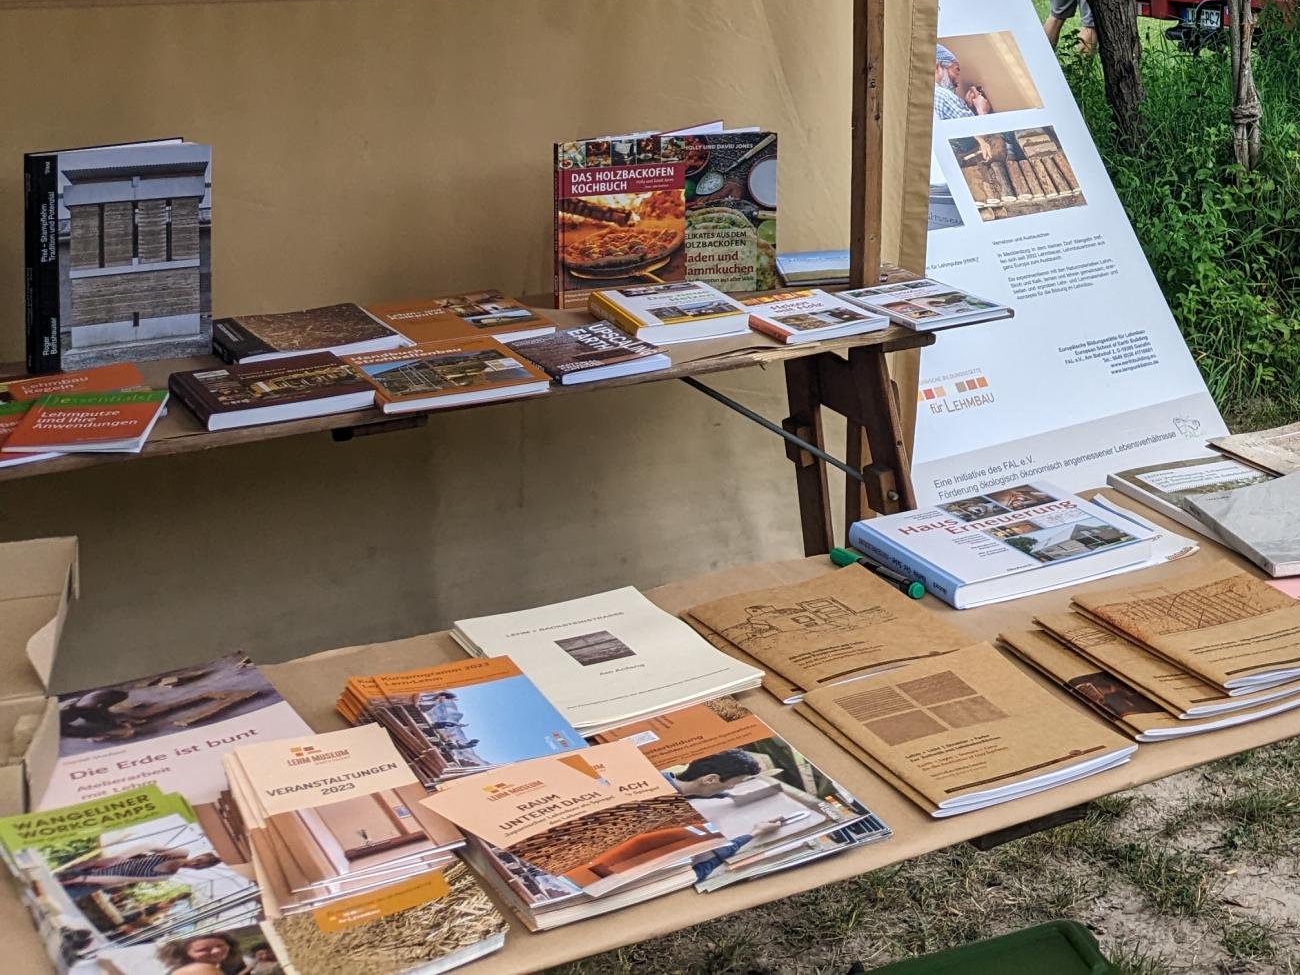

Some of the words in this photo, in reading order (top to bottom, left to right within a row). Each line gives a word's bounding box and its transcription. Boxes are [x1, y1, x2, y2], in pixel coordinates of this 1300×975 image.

[704, 143, 716, 151] UND
[716, 143, 735, 151] DAVID
[571, 171, 593, 184] DAS
[596, 167, 675, 182] HOLZBACKOFEN
[571, 181, 628, 195] KOCHBUCH
[685, 232, 715, 241] ELIKATES
[716, 231, 730, 239] AUS
[730, 231, 747, 239] DEM
[686, 240, 747, 249] OLZBACKOFEN
[685, 251, 714, 263] laden
[717, 251, 739, 261] und
[685, 264, 754, 277] lammkuchen
[42, 336, 52, 357] Roger
[568, 327, 612, 351] EARTH
[588, 323, 657, 357] UPSCALING
[351, 347, 424, 362] Handbuch
[354, 347, 463, 365] Strohballenbau
[20, 375, 88, 391] Lehmbau
[23, 383, 75, 395] Regeln
[930, 403, 943, 415] für
[943, 393, 995, 413] LEHMBAU
[41, 409, 120, 418] Lehmputze
[32, 419, 138, 430] Anwendungen
[933, 477, 952, 489] Eine
[953, 469, 987, 484] Initiative
[988, 464, 1003, 475] des
[1003, 459, 1020, 472] FAL
[1020, 455, 1036, 466] e.V.
[938, 483, 980, 501] Förderung
[980, 472, 1020, 489] ökologisch
[1020, 462, 1062, 479] ökonomisch
[1063, 447, 1114, 467] angemessener
[1114, 431, 1177, 453] Lebensverhältnisse
[897, 516, 961, 537] Haus
[947, 499, 1078, 536] Erneuerung
[380, 666, 464, 682] Kursprogramm
[464, 661, 490, 671] 2023
[384, 676, 444, 687] Lern-Lehm
[69, 765, 109, 781] Die
[116, 753, 169, 770] Erde
[174, 743, 200, 757] ist
[205, 728, 260, 749] bunt
[287, 756, 312, 767] LEHM
[312, 749, 350, 762] MUSEUM
[76, 765, 172, 793] Atelierarbeit
[265, 762, 399, 797] VERANSTALTUNGEN
[618, 780, 650, 793] ACH
[81, 789, 109, 800] mit
[321, 783, 356, 796] 2023
[498, 804, 562, 831] UNTERM
[560, 791, 602, 807] DACH
[516, 793, 561, 812] RAUM
[16, 793, 150, 832] WANGELINER
[17, 803, 157, 840] WORKCAMPS
